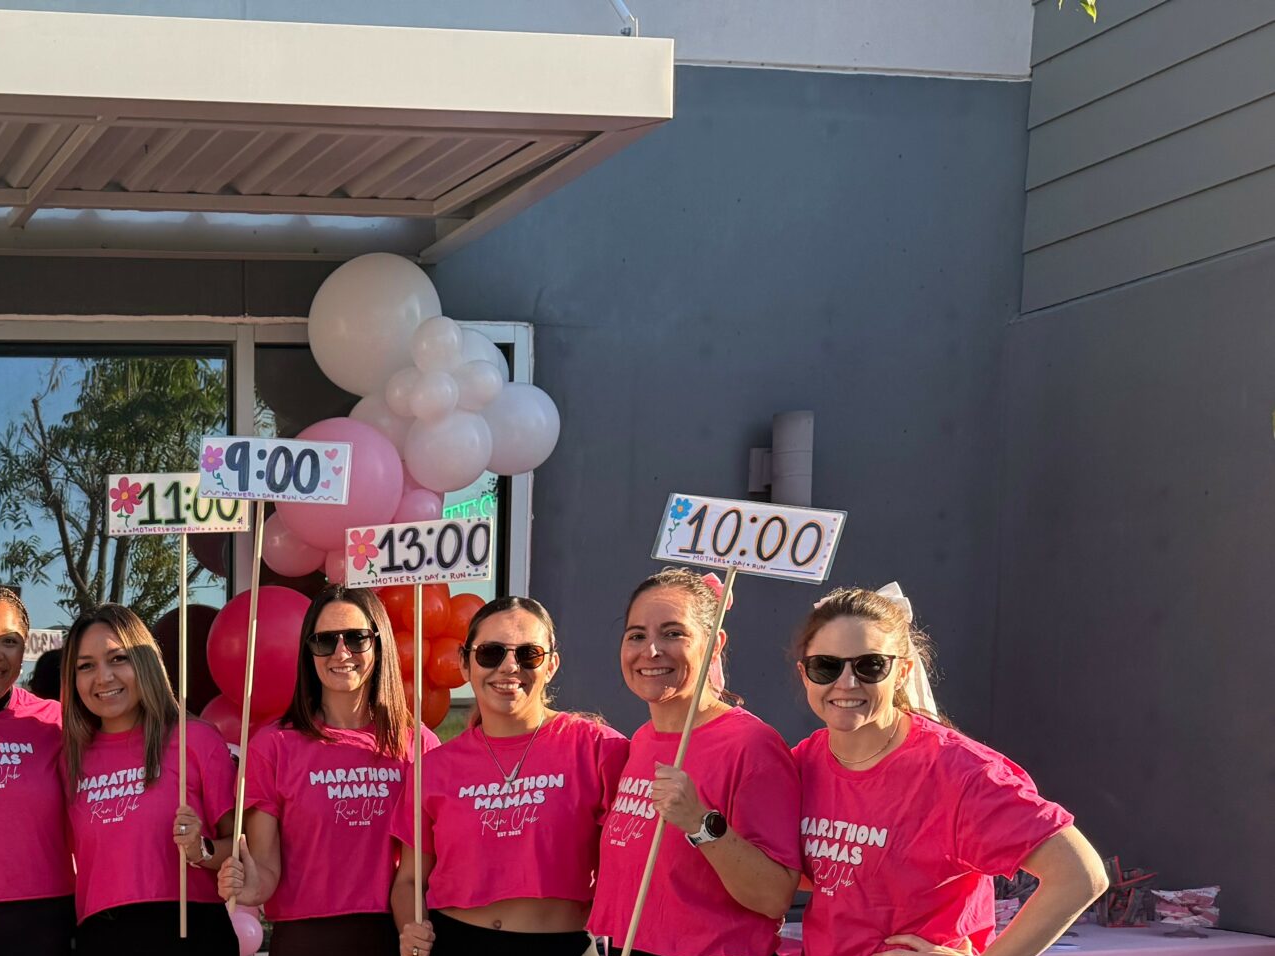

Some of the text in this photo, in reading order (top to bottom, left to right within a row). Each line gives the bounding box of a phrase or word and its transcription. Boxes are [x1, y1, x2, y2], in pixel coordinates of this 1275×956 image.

[225, 441, 321, 494] 9:00
[678, 504, 823, 567] 10:00
[378, 523, 490, 572] 13:00
[692, 554, 725, 564] MOTHERS
[375, 572, 466, 585] MOTHERS DAY RUN
[309, 767, 401, 785] MARATHON
[458, 774, 564, 798] MARATHON
[87, 781, 145, 803] MAMAS
[327, 782, 389, 799] MAMAS
[474, 790, 545, 810] MAMAS
[805, 838, 863, 865] MAMAS
